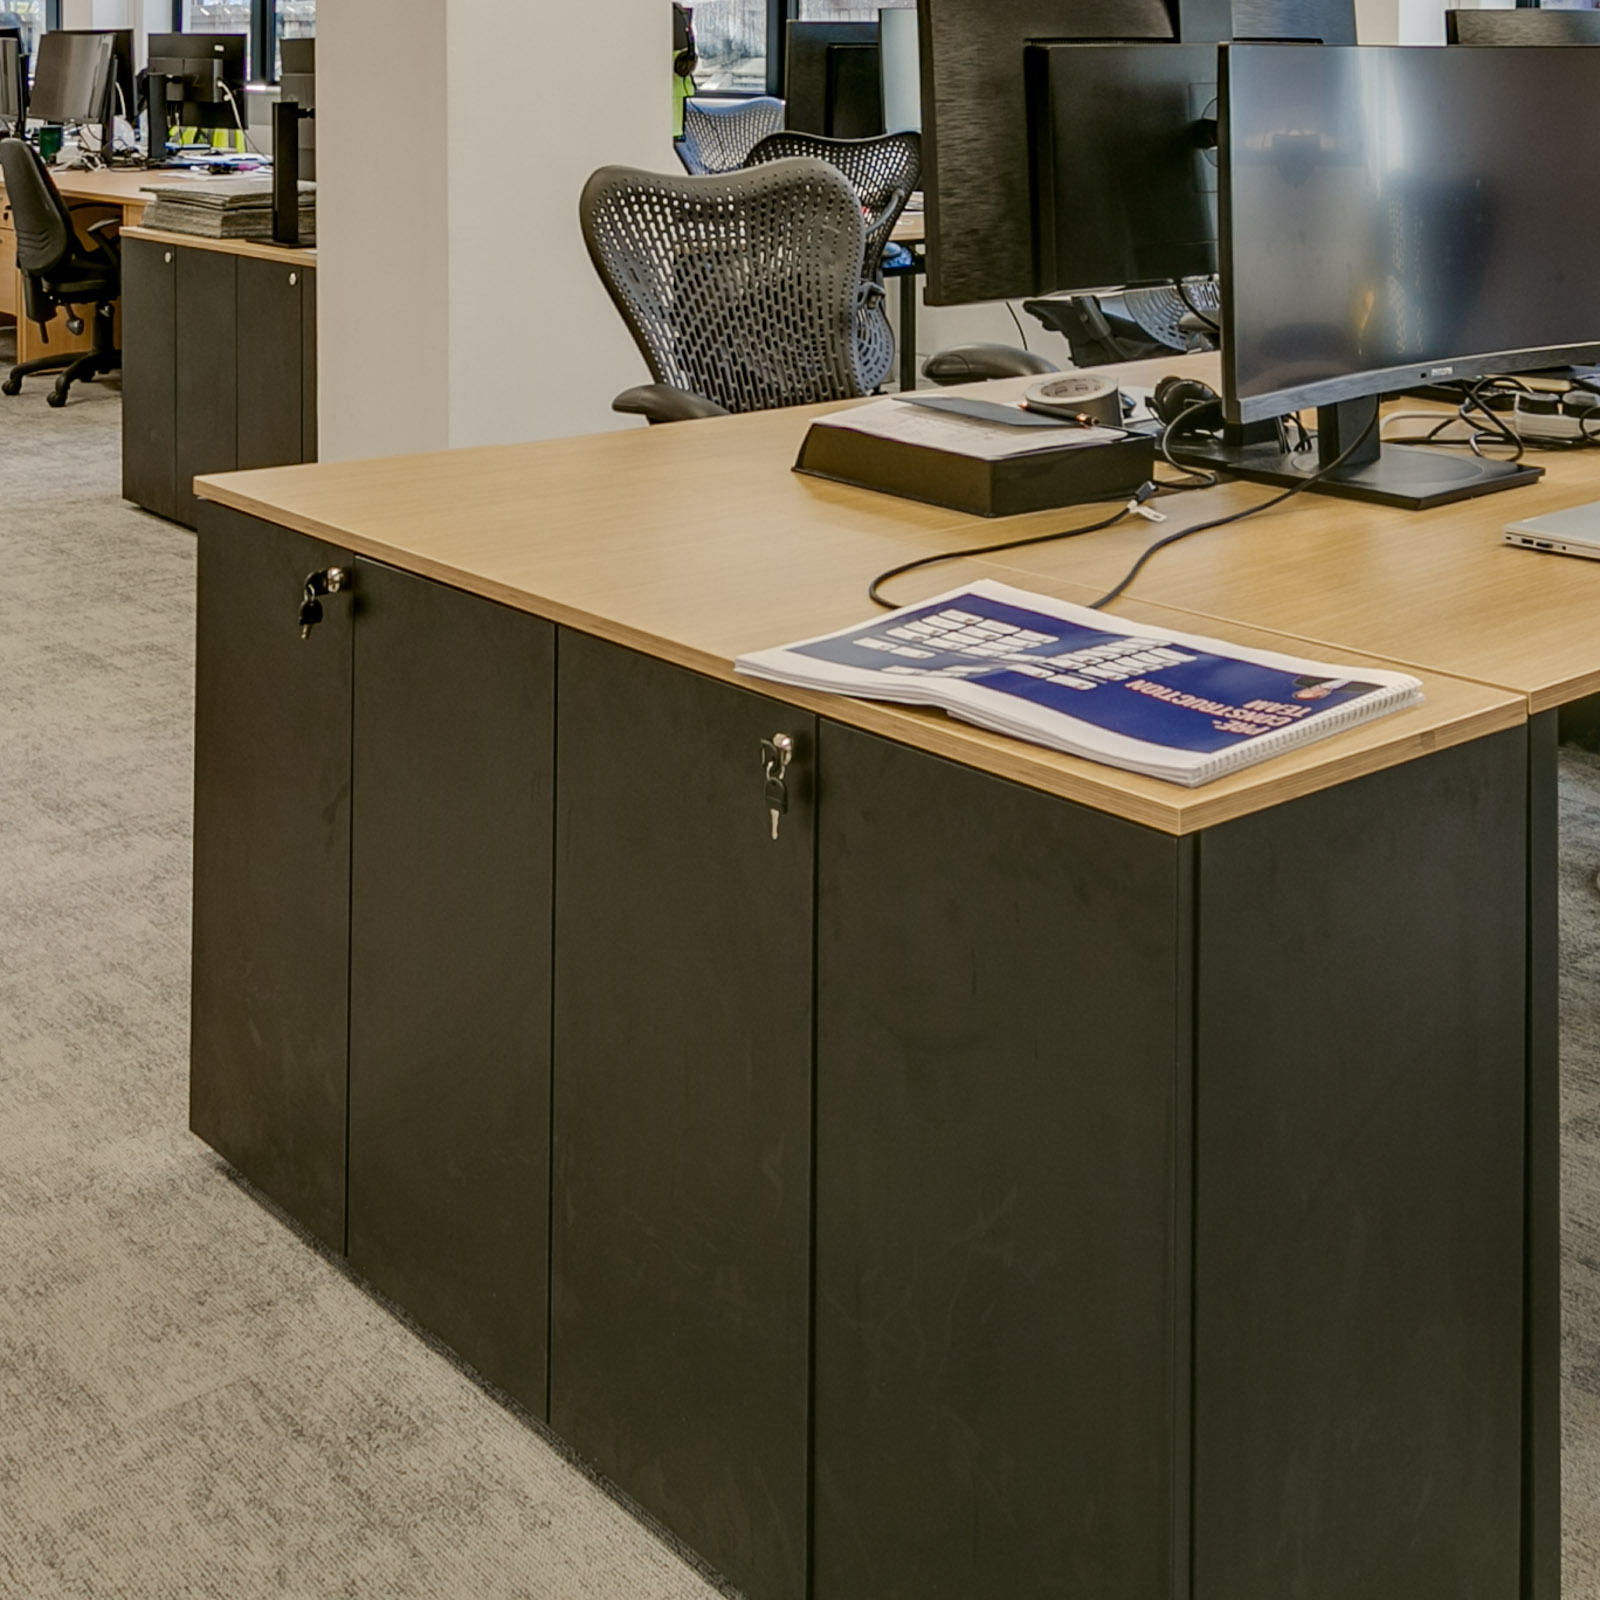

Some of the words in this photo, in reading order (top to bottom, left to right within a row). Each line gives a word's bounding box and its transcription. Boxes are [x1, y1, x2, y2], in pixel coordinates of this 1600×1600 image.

[1125, 679, 1292, 727] CONSTRUCTION
[1243, 699, 1312, 718] TEAM
[1212, 719, 1271, 736] PRE-
